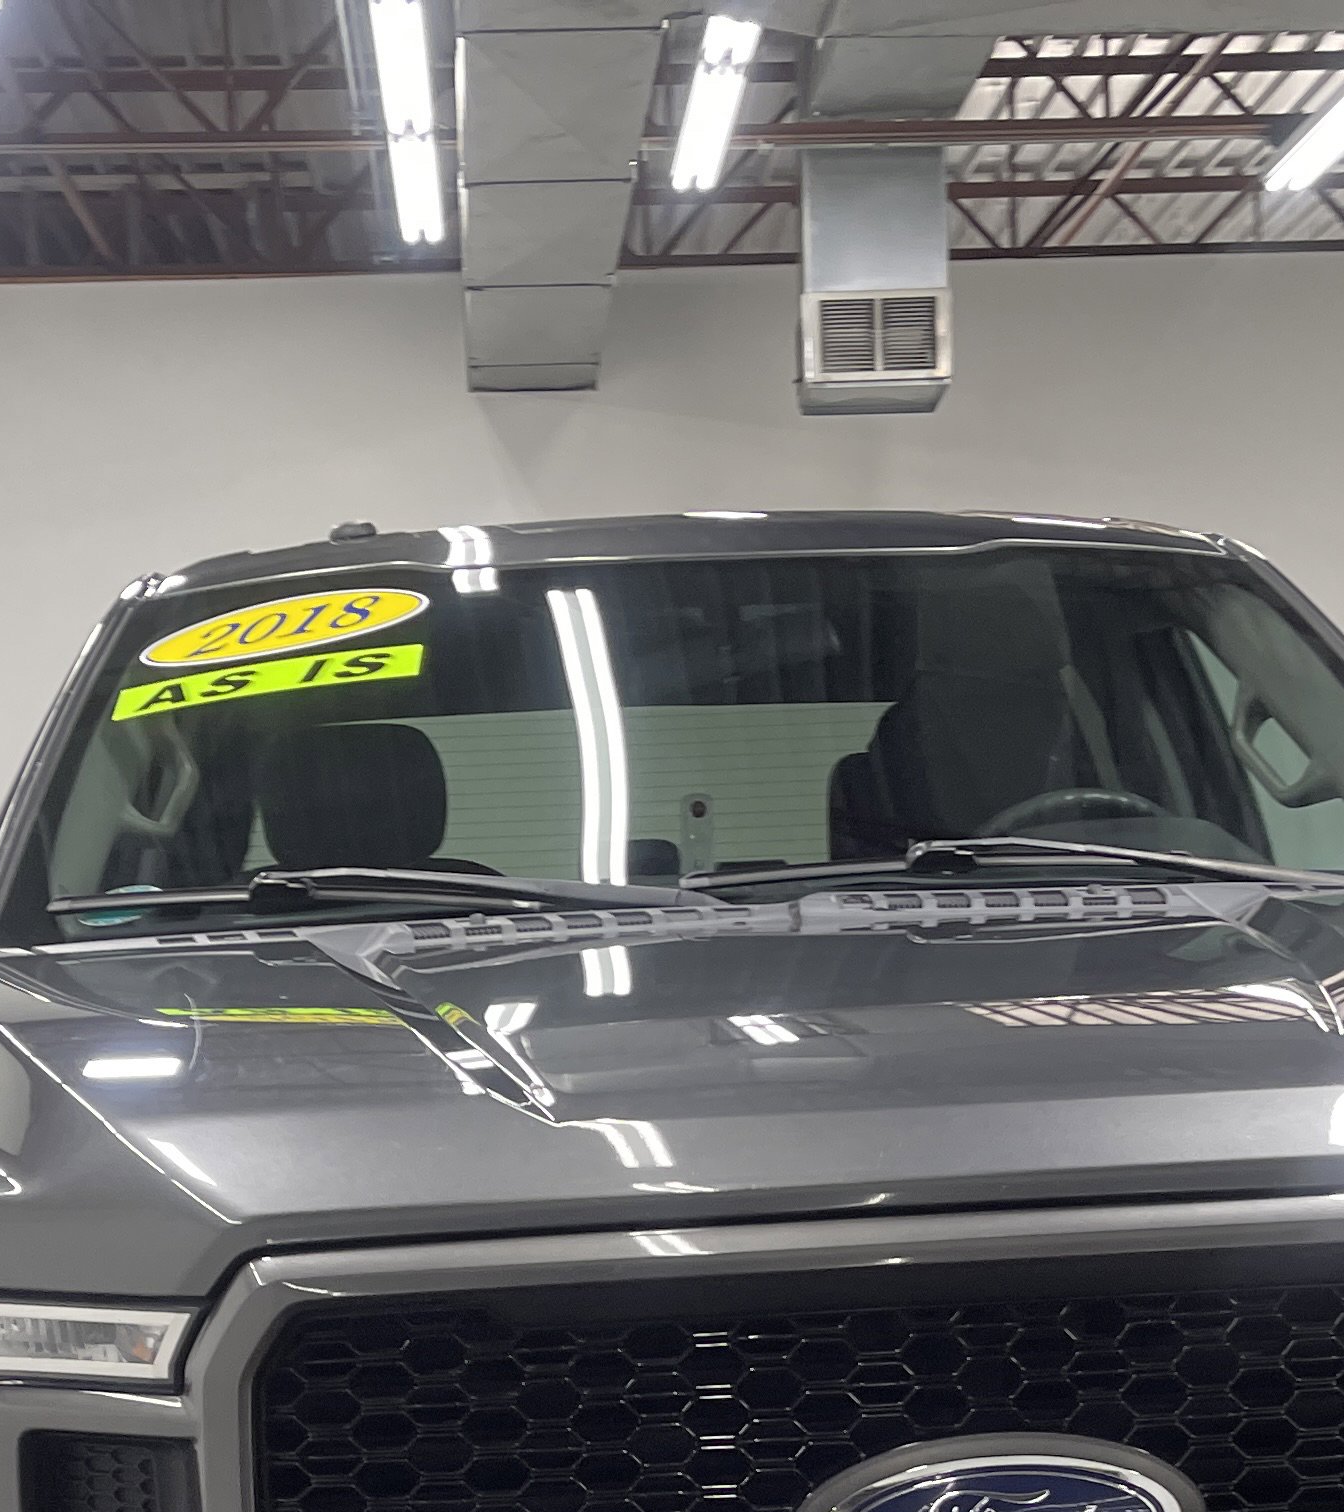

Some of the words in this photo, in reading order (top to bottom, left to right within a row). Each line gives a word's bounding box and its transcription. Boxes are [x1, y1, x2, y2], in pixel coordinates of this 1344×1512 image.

[187, 595, 381, 658] 2018
[137, 670, 256, 712] AS
[300, 653, 393, 684] IS
